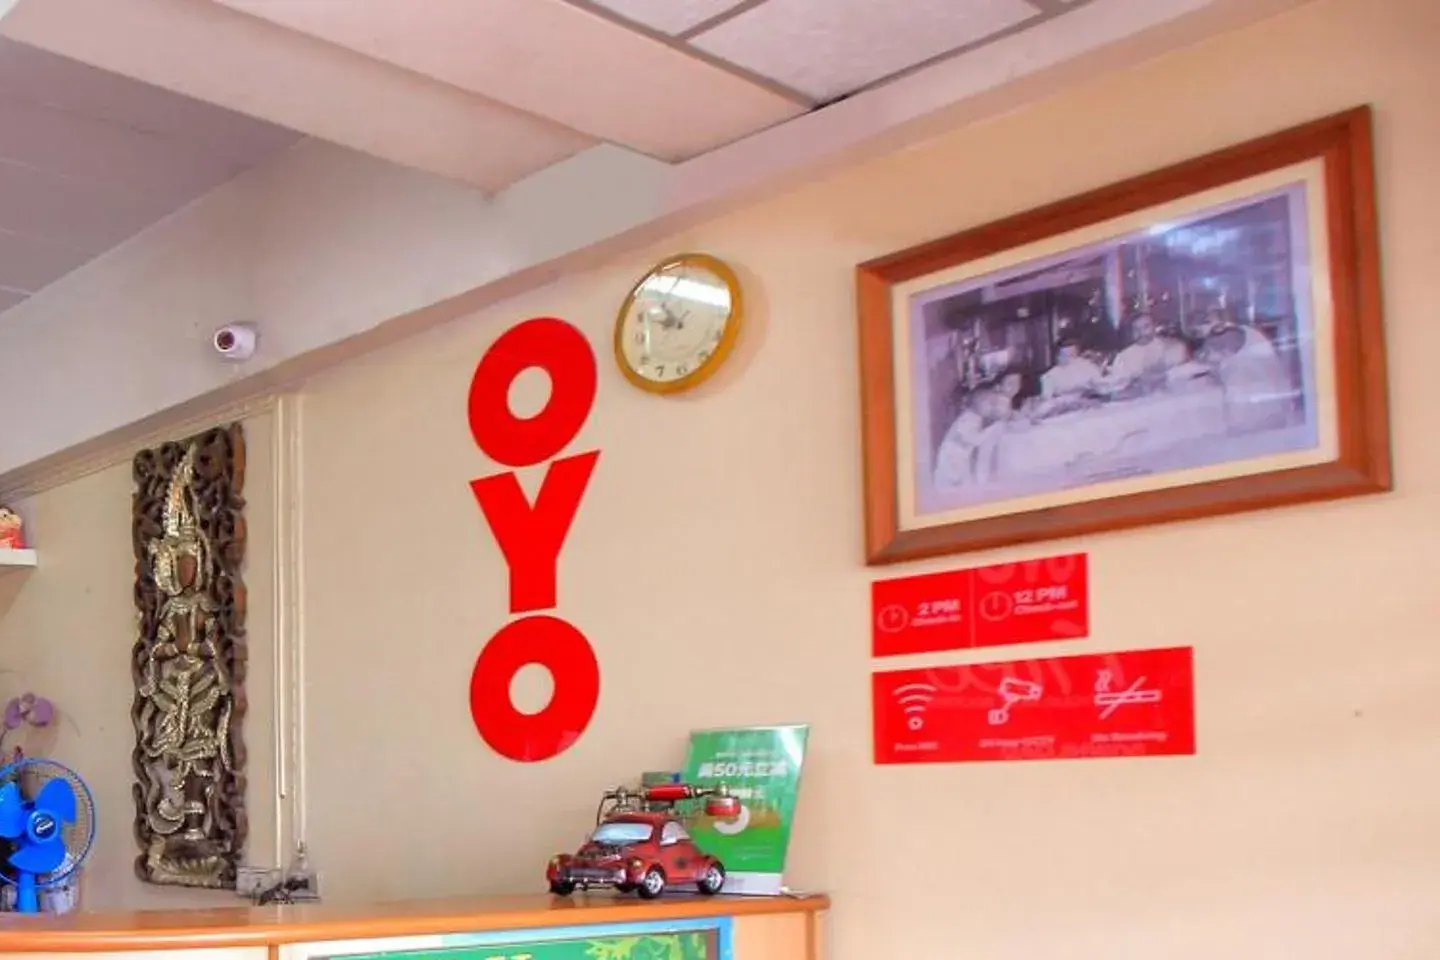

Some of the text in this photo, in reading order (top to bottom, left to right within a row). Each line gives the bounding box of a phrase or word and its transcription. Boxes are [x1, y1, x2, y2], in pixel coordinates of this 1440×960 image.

[467, 317, 602, 764] OYO
[1014, 585, 1069, 605] 12 PM
[932, 599, 961, 614] PM
